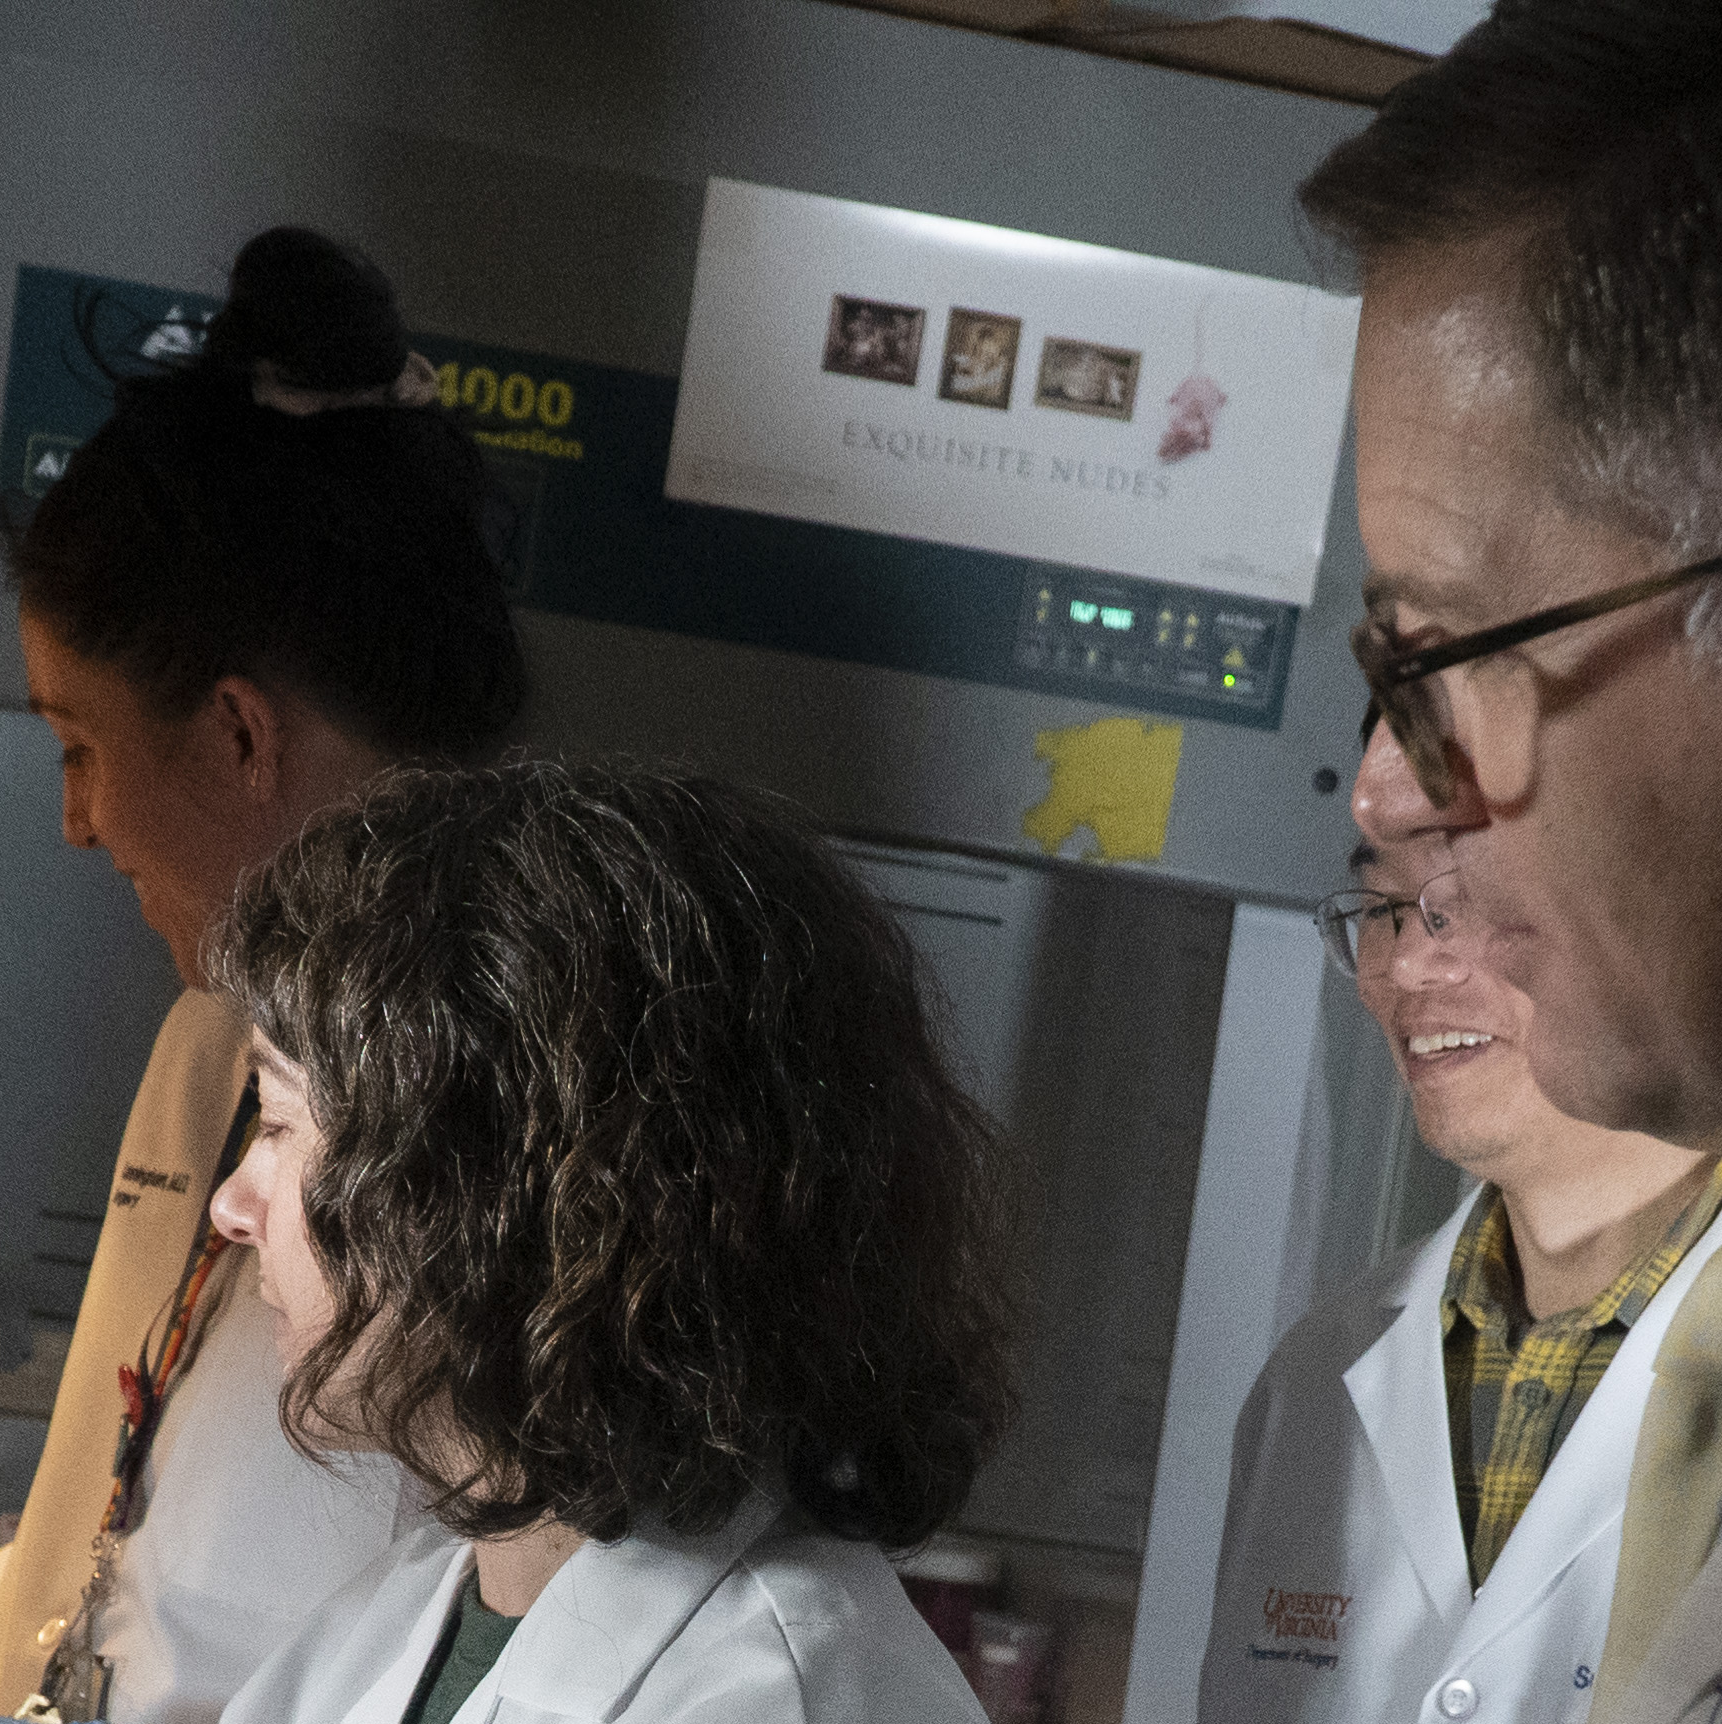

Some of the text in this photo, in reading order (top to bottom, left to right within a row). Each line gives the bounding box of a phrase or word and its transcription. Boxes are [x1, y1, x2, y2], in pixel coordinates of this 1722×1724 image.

[843, 421, 1172, 500] EXQUISITE NUDES
[1573, 1665, 1595, 1691] S
